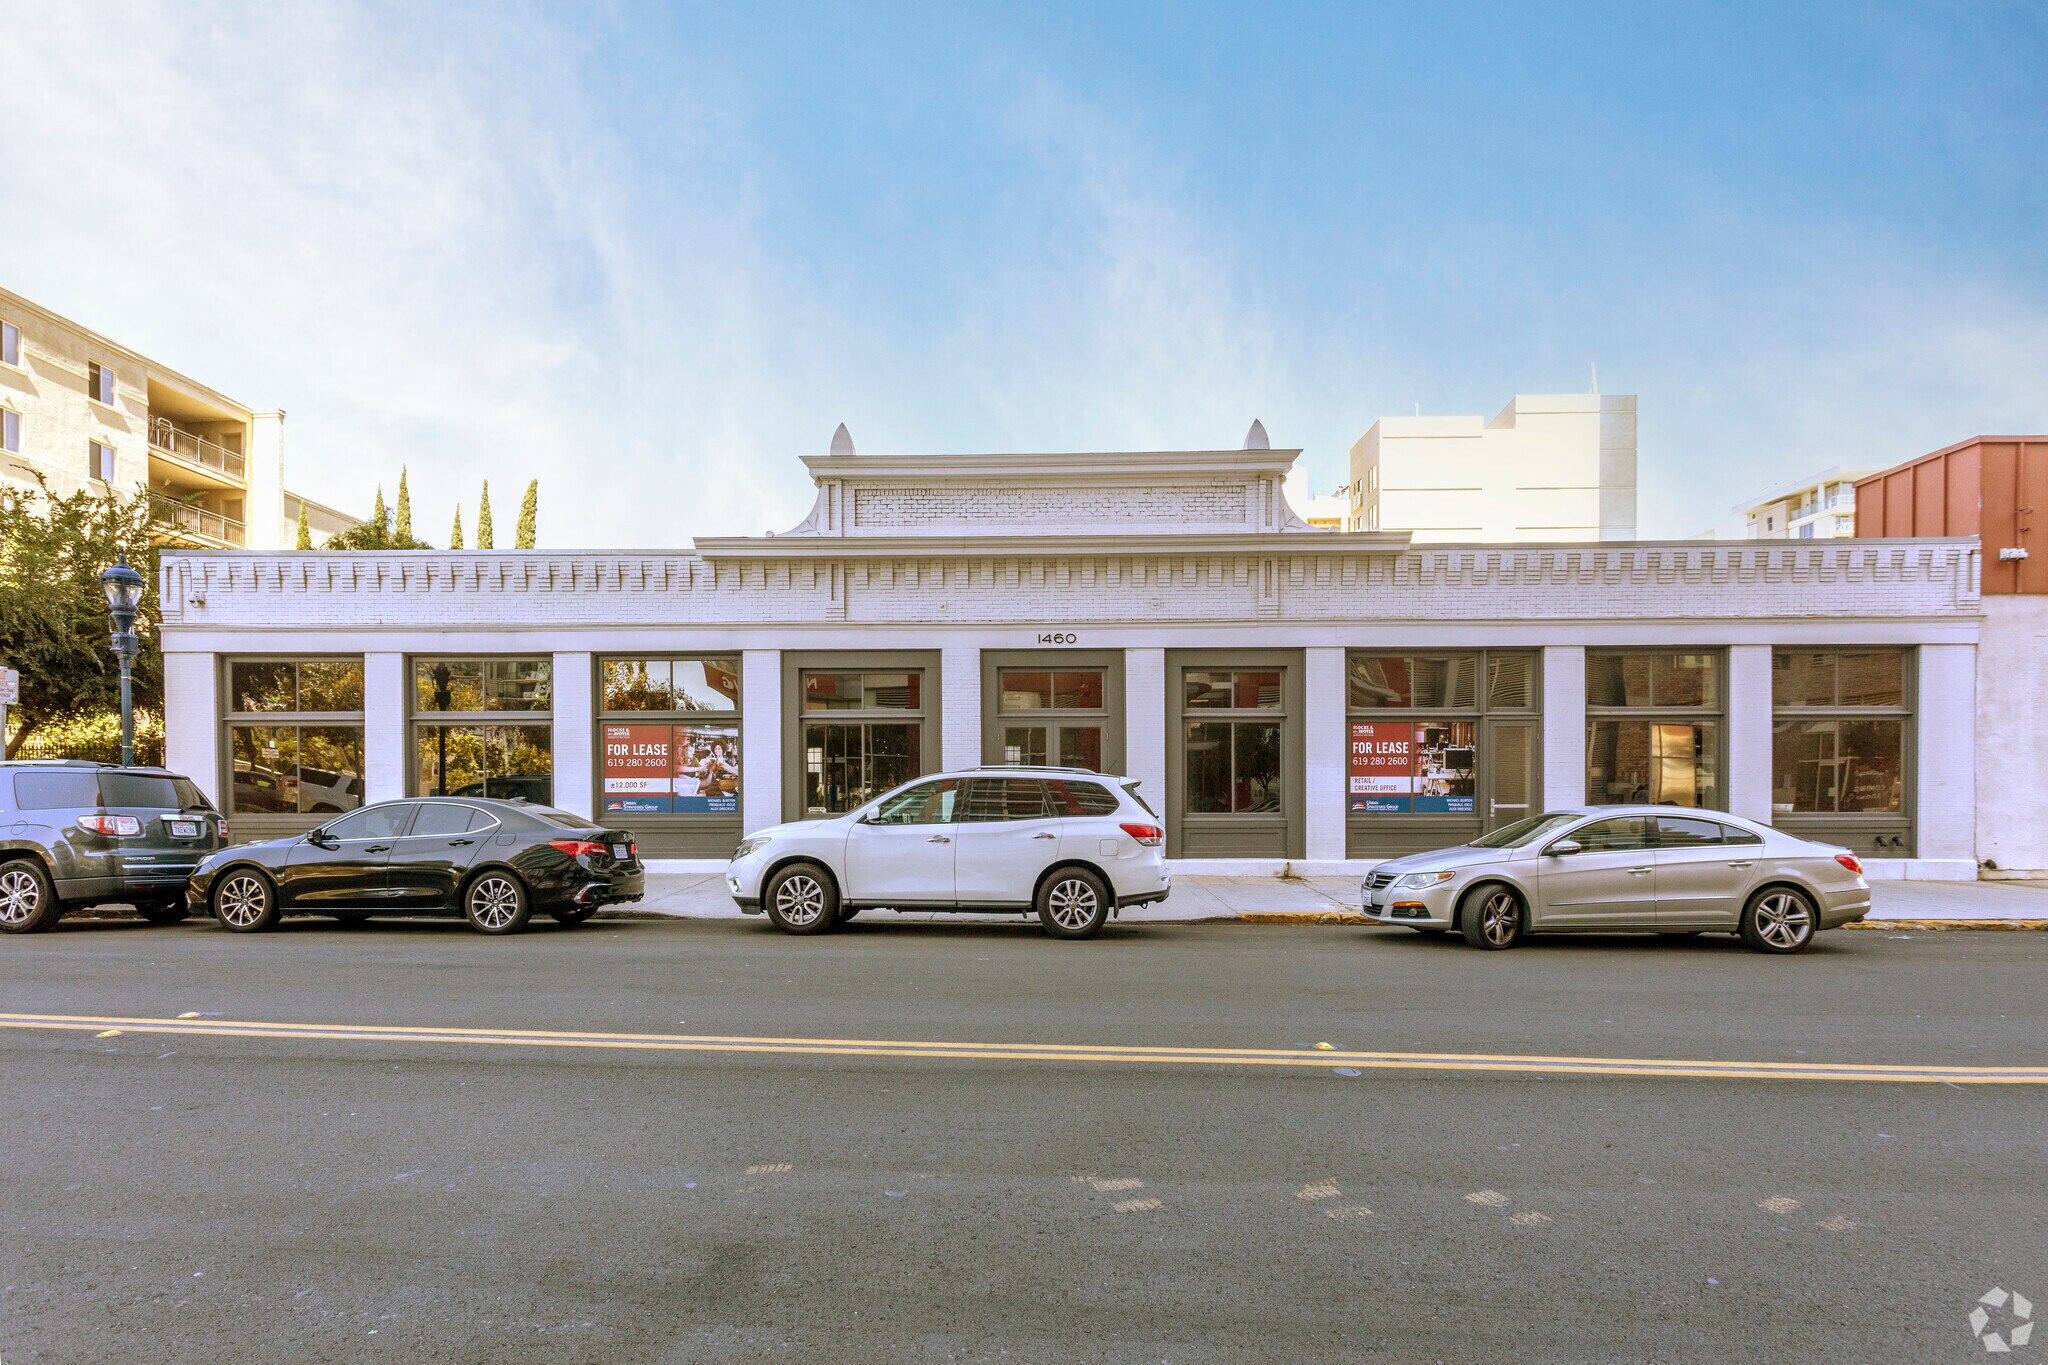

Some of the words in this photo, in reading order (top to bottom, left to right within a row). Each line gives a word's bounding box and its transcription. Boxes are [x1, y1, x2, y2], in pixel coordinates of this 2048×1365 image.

[1038, 634, 1076, 644] 1460
[608, 744, 628, 756] FOR
[633, 744, 668, 756] LEASE
[1353, 742, 1372, 754] FOR
[1376, 742, 1409, 754] LEASE
[1353, 757, 1368, 765] 619
[1370, 757, 1385, 765] 280
[1388, 757, 1408, 765] 2600
